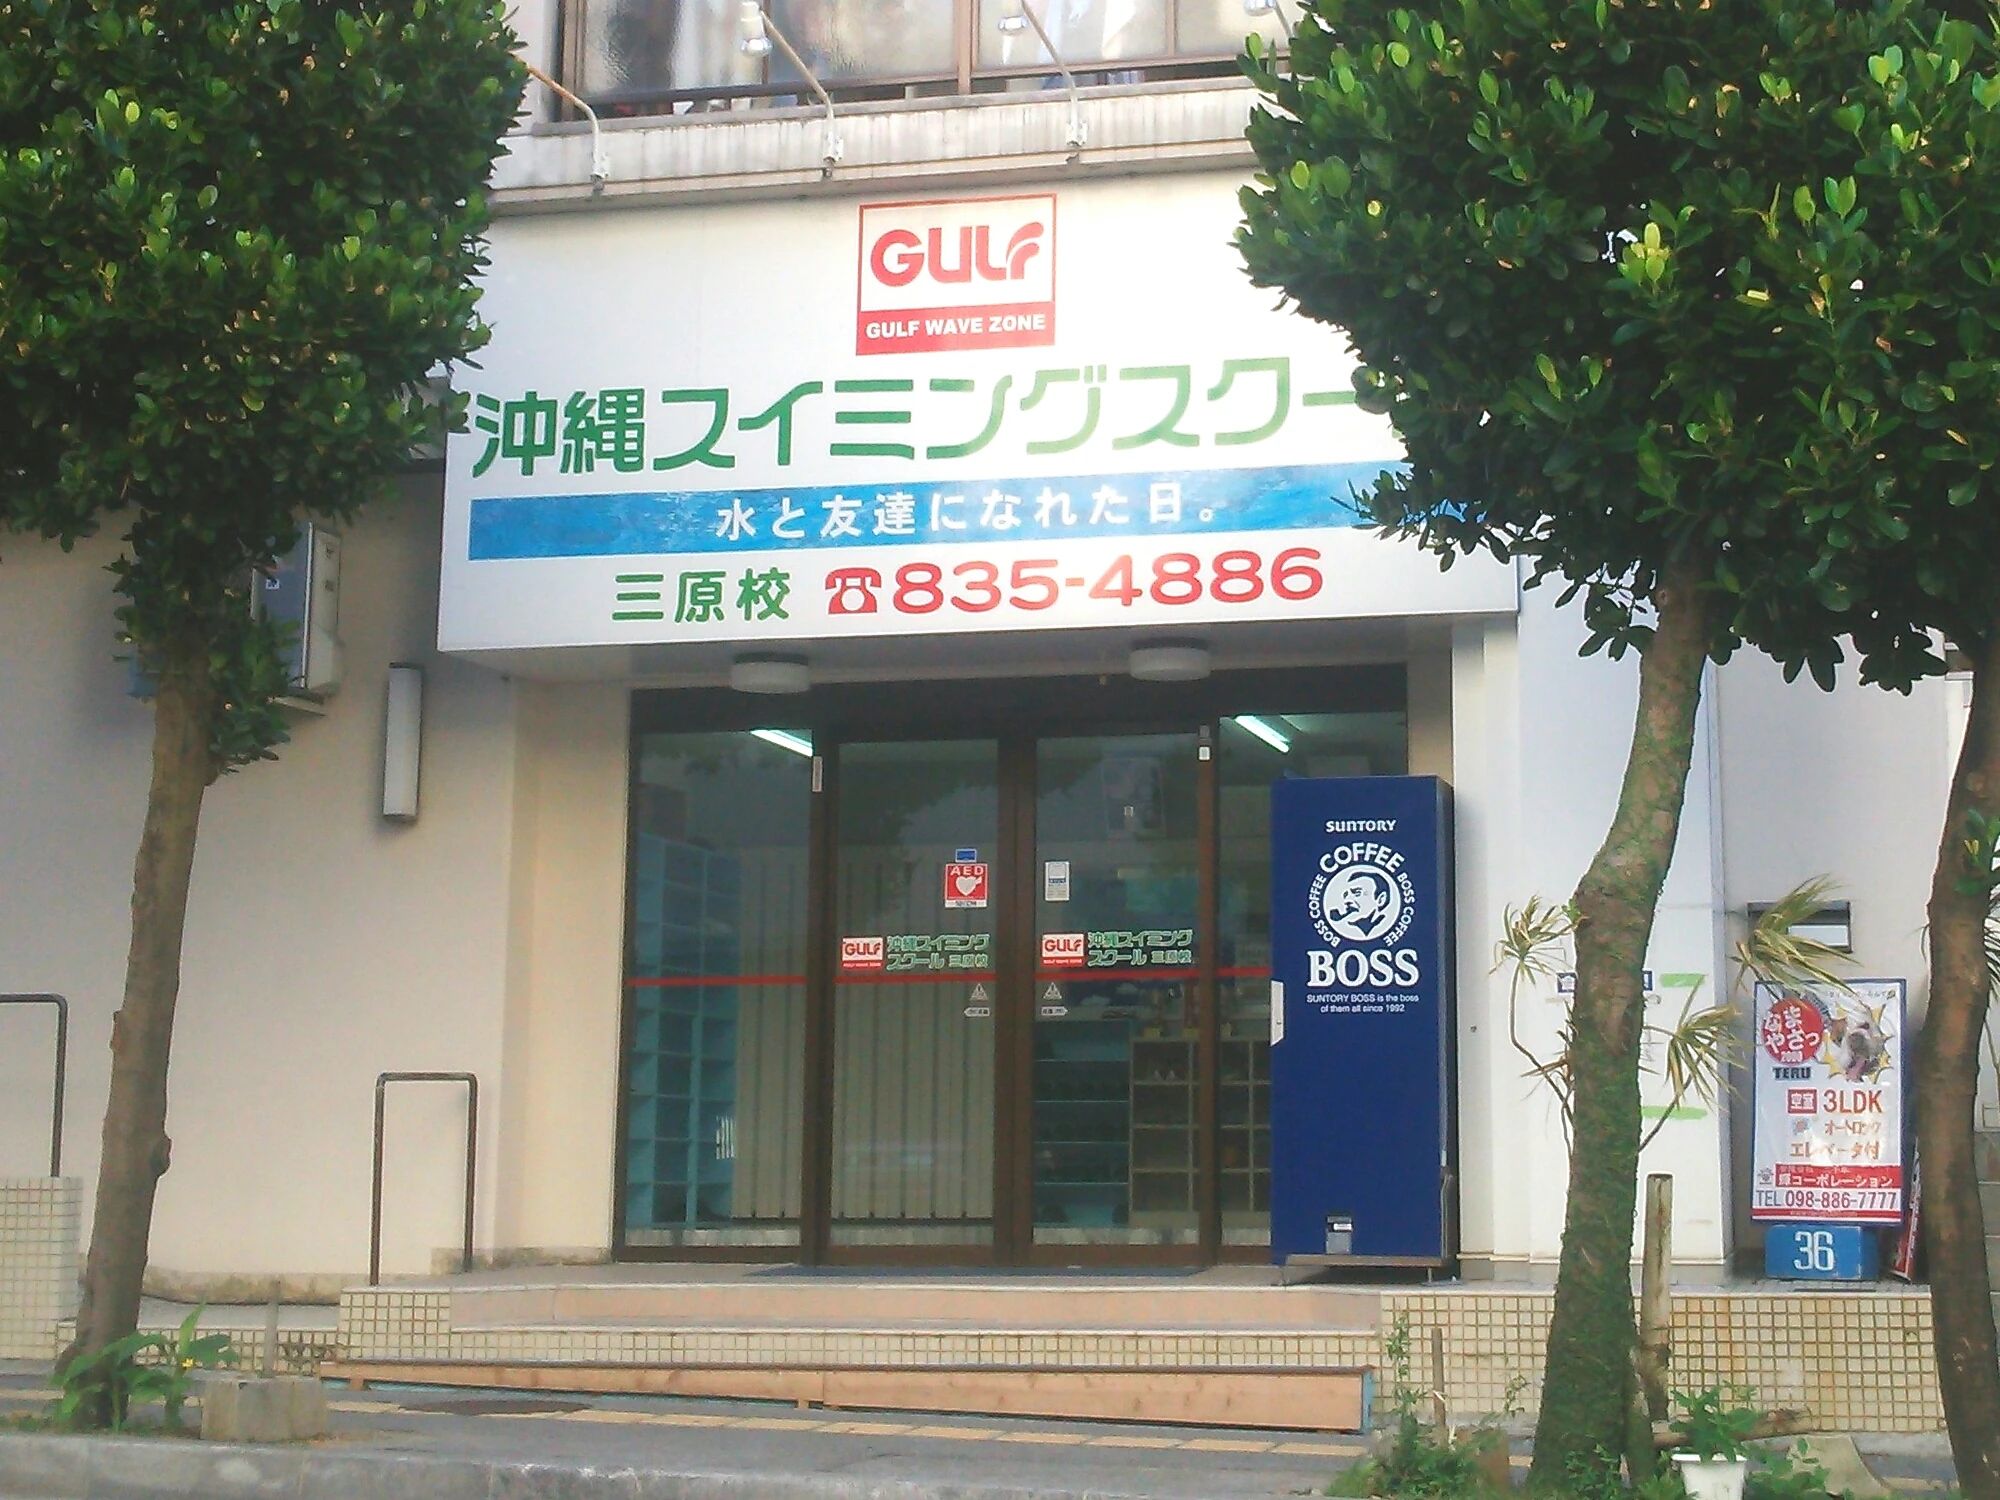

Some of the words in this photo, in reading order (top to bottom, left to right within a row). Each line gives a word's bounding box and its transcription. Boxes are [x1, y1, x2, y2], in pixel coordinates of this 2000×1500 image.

[870, 221, 1045, 288] GULF
[865, 320, 921, 339] GULF
[924, 317, 984, 336] WAVE
[988, 313, 1047, 333] ZONE
[472, 356, 1405, 479] 沖縄スイミングスクー
[715, 482, 1213, 542] 水と友達になれた日。
[611, 567, 791, 624] 三原校
[892, 546, 1324, 615] 835-4886
[950, 865, 984, 876] AED
[1319, 841, 1405, 873] COFFEE
[1308, 873, 1327, 919] COFFEE
[1397, 872, 1416, 904] BOSS
[1313, 919, 1342, 948] BOSS
[1383, 906, 1416, 947] COFFEE
[844, 942, 882, 956] GULF
[1044, 938, 1082, 953] GULF
[1087, 948, 1148, 967] スクール
[886, 952, 945, 971] スクール
[1306, 948, 1420, 987] BOSS
[1306, 994, 1349, 1003] SUNTORY
[1350, 994, 1376, 1003] BOSS
[1377, 994, 1384, 1003] is
[1385, 994, 1398, 1003] the
[1399, 994, 1420, 1003] boss
[1320, 1004, 1329, 1013] of
[1330, 1004, 1350, 1013] them
[1351, 1004, 1361, 1013] all
[1362, 1004, 1384, 1013] since
[1385, 1003, 1405, 1013] 1992
[1773, 1066, 1812, 1080] TERU
[1822, 1088, 1883, 1114] 3LDK
[1755, 1190, 1781, 1207] TEL
[1785, 1190, 1897, 1210] 098-886-7777
[1793, 1230, 1835, 1271] 36
